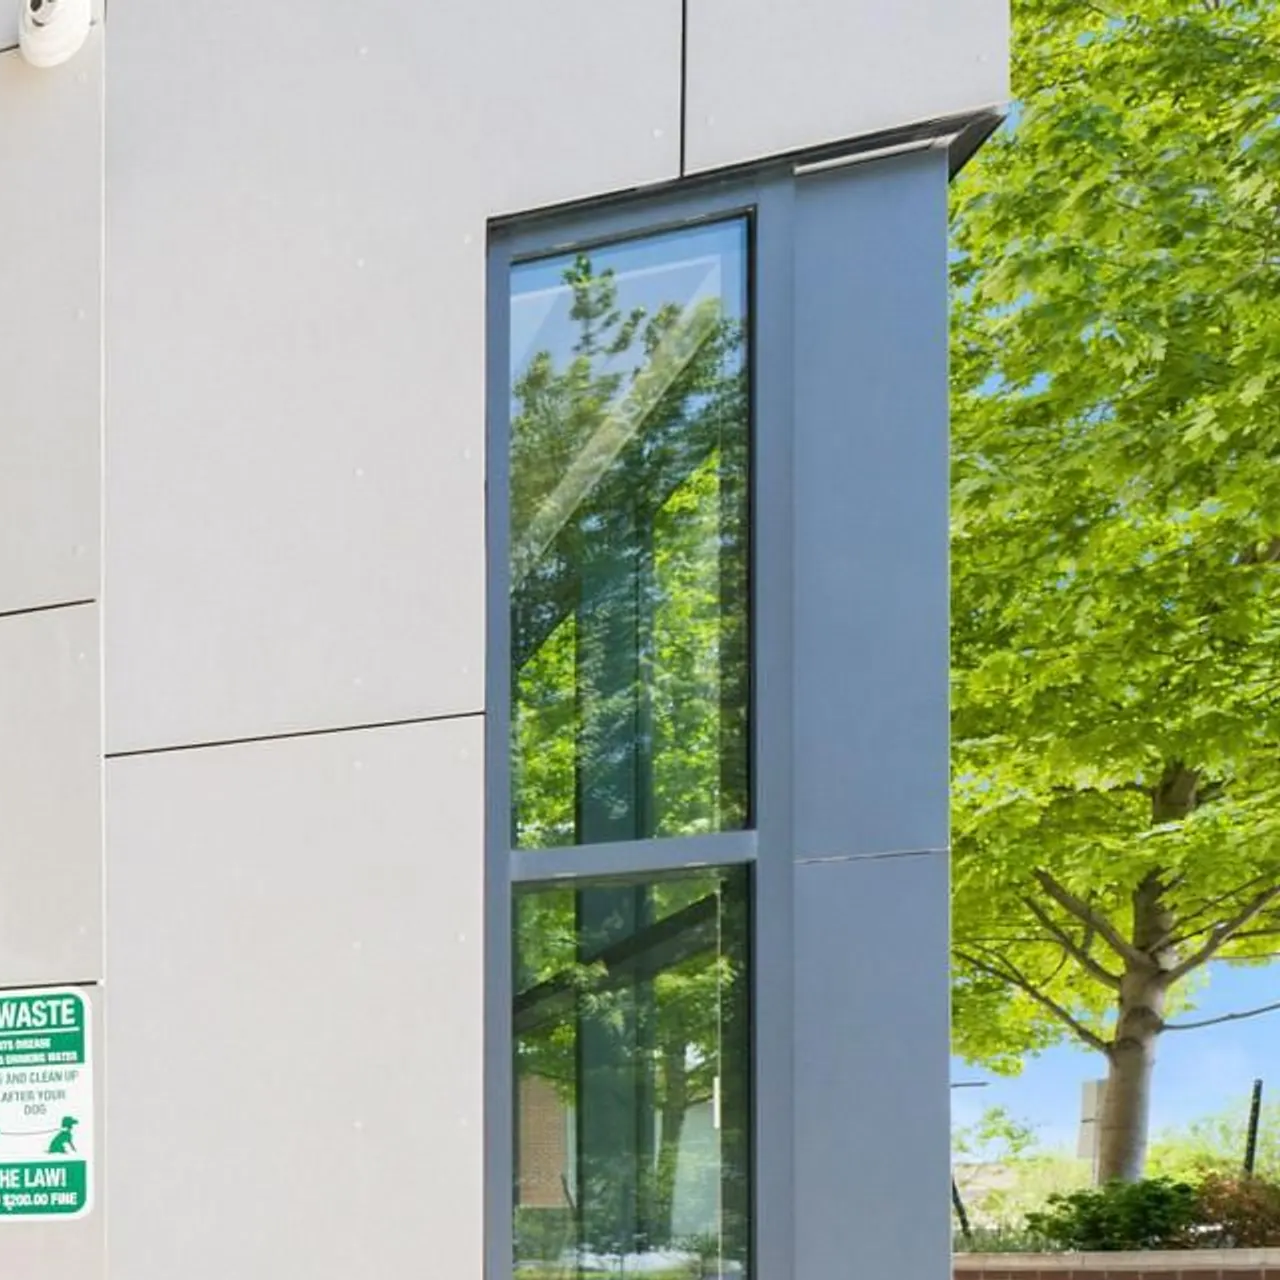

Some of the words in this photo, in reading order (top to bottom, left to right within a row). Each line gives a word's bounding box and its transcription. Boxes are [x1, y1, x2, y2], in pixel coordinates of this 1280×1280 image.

[5, 1072, 27, 1085] AND
[30, 1070, 62, 1083] CLEAN
[64, 1069, 79, 1081] UP
[0, 1090, 35, 1103] AFTER
[38, 1089, 66, 1101] YOUR
[24, 1104, 47, 1116] DOG
[24, 1167, 67, 1188] LAW!
[50, 1192, 77, 1205] FINE
